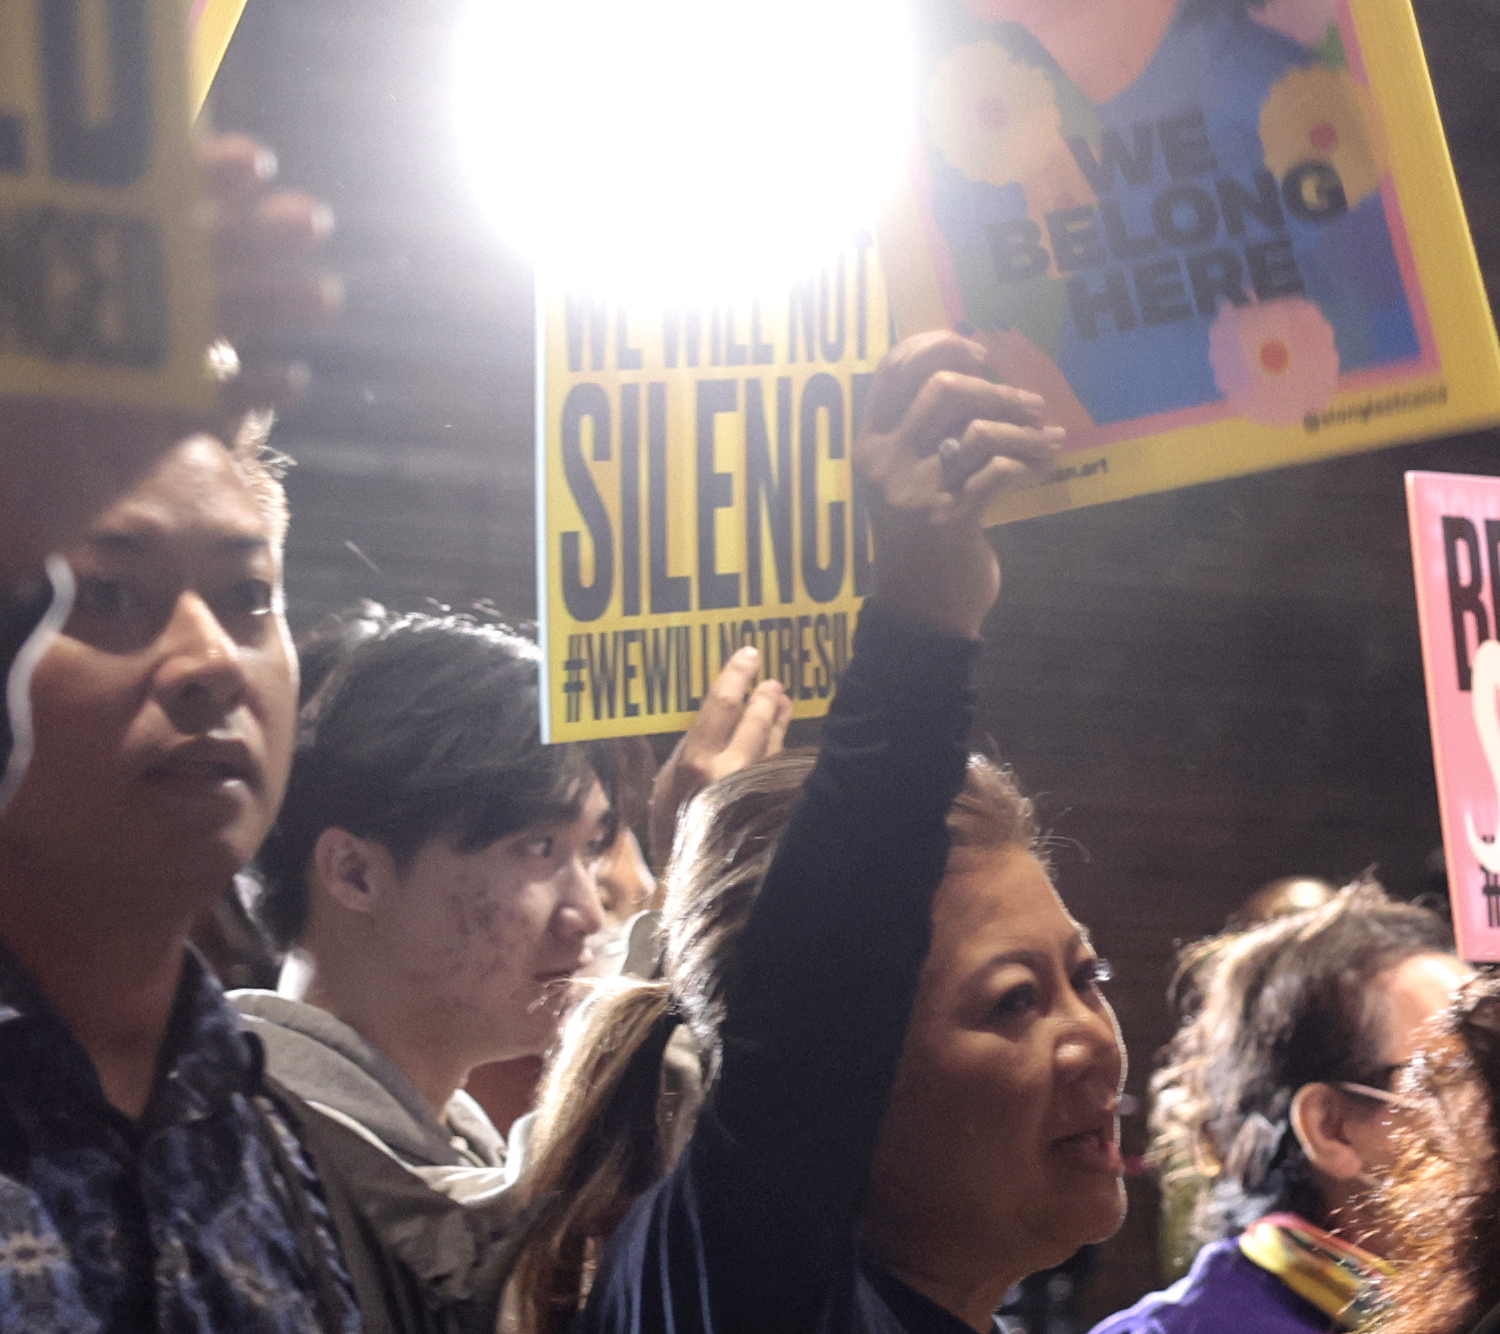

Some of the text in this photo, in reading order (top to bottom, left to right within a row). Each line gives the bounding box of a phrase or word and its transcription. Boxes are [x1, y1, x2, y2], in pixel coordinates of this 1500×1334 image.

[1062, 105, 1220, 196] WE
[985, 157, 1349, 286] BELONG
[1064, 236, 1306, 342] HERE
